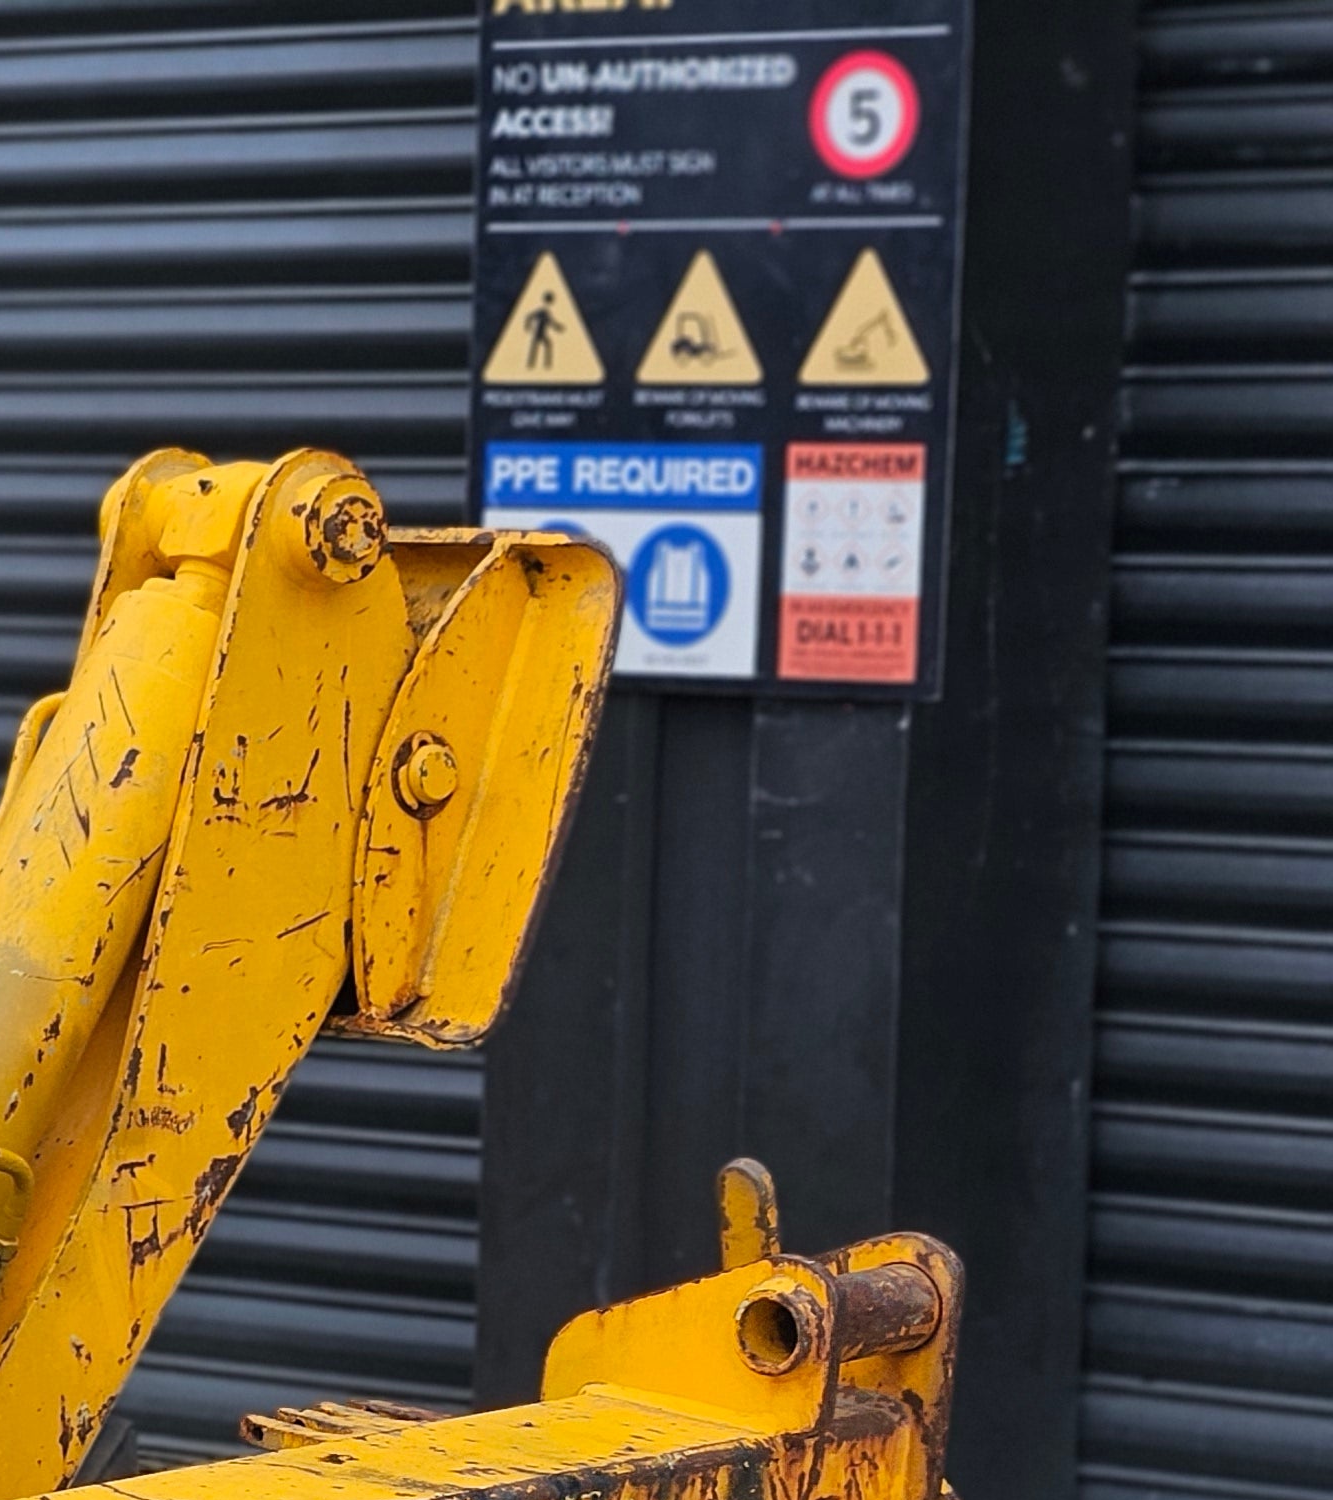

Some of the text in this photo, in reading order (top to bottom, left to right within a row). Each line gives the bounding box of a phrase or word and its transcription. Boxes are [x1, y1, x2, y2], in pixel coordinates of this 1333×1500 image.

[492, 55, 798, 94] NO UN-AUTHORIZED
[491, 105, 614, 139] ACCESS!
[847, 88, 882, 146] 5
[489, 155, 523, 178] ALL
[536, 182, 642, 206] RECEPTION
[491, 456, 756, 496] PPE REQUIRED
[795, 453, 917, 475] HAZCHEM
[796, 619, 852, 646] DIAL
